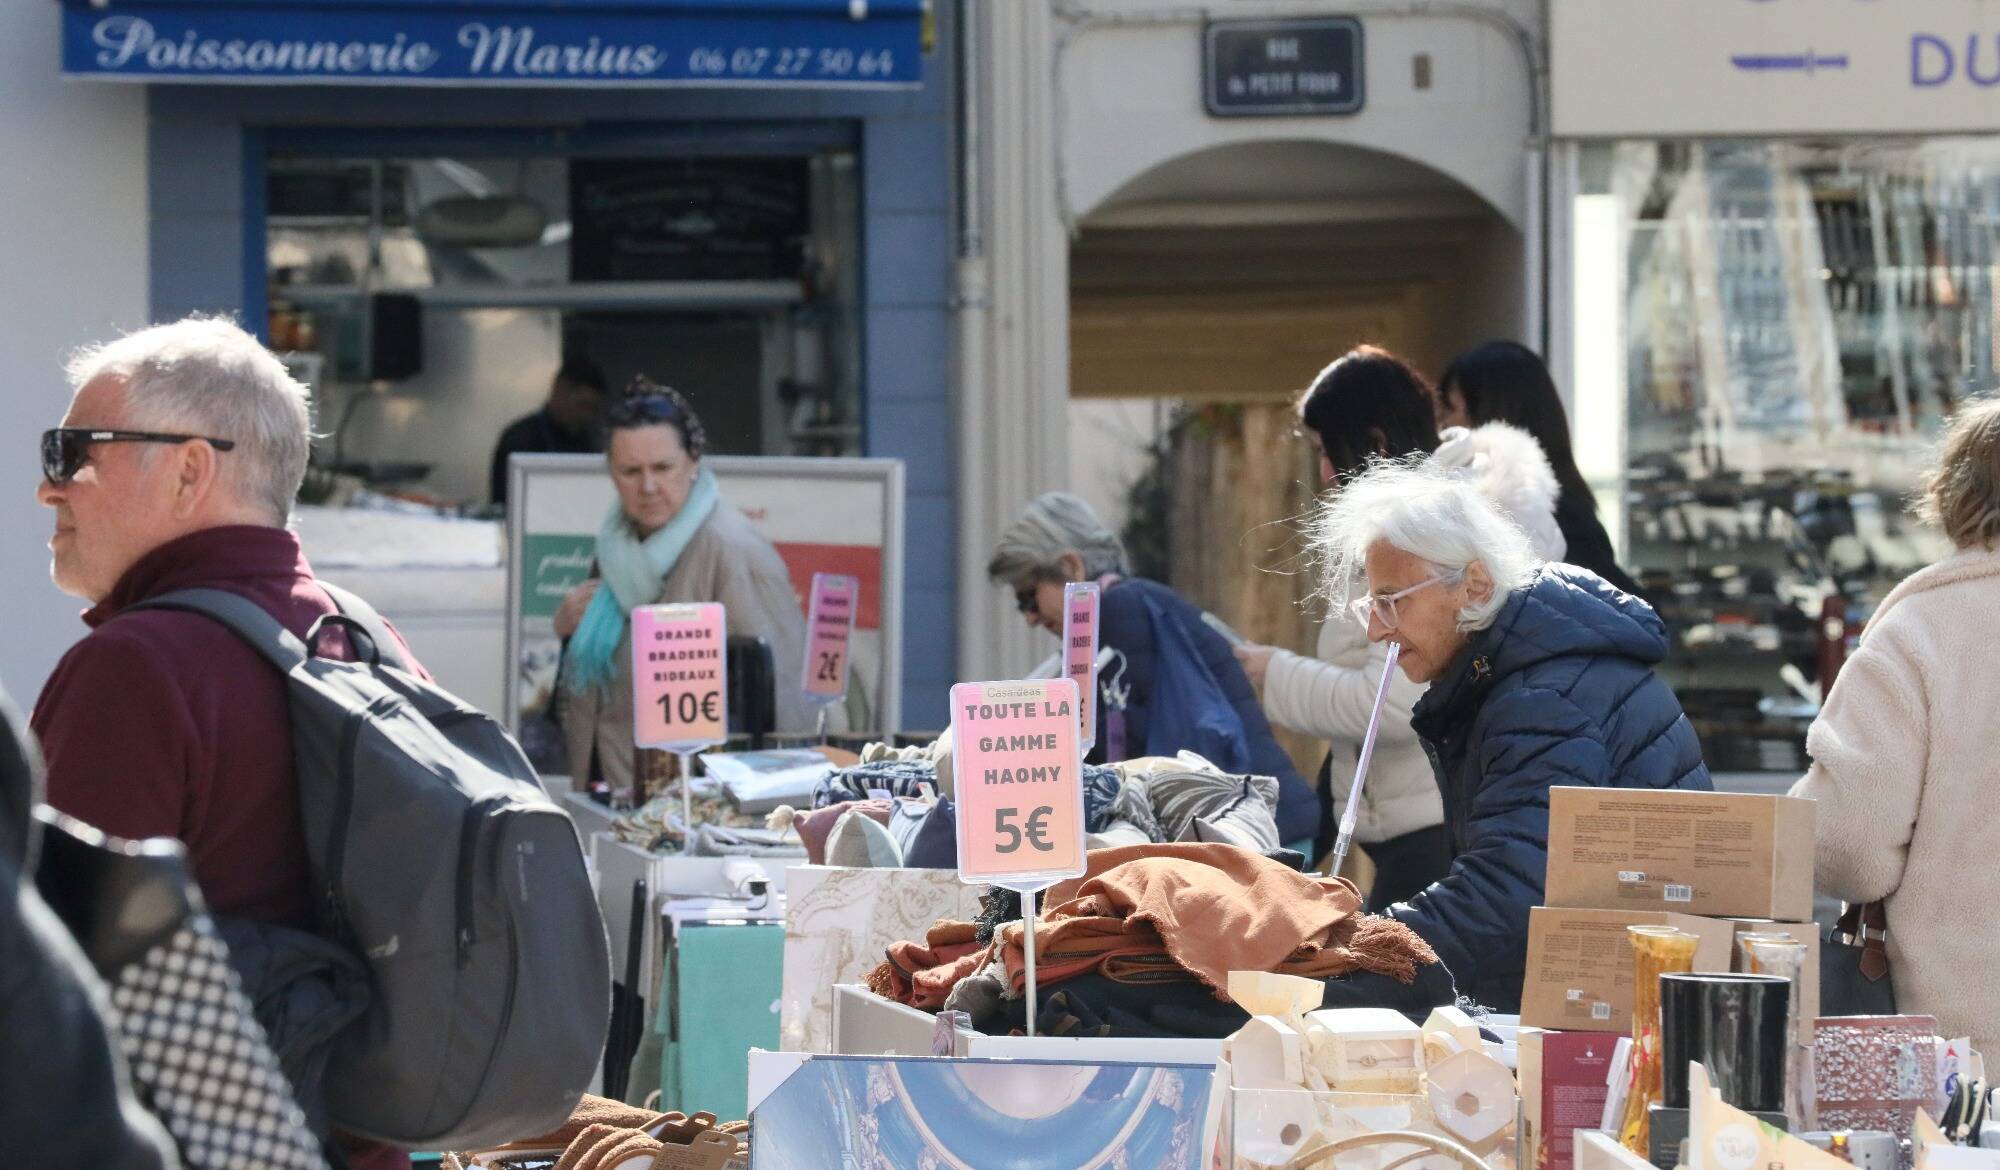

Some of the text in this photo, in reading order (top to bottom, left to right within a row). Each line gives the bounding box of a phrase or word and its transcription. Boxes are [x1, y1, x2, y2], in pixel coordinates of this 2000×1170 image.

[93, 15, 438, 73] Poissonnerie
[457, 22, 667, 75] Marius
[688, 46, 726, 74] 06
[730, 46, 768, 75] 07
[773, 47, 811, 75] 27
[655, 629, 712, 641] GRANDE
[648, 649, 718, 662] BRADERIE
[653, 669, 716, 682] RIDEAUX
[987, 686, 1041, 698] Casaideas
[657, 691, 721, 725] 10€
[965, 702, 1037, 721] TOUTE
[1044, 700, 1071, 717] LA
[979, 733, 1057, 753] GAMME
[984, 766, 1062, 785] HAOMY
[995, 805, 1055, 854] 5€
